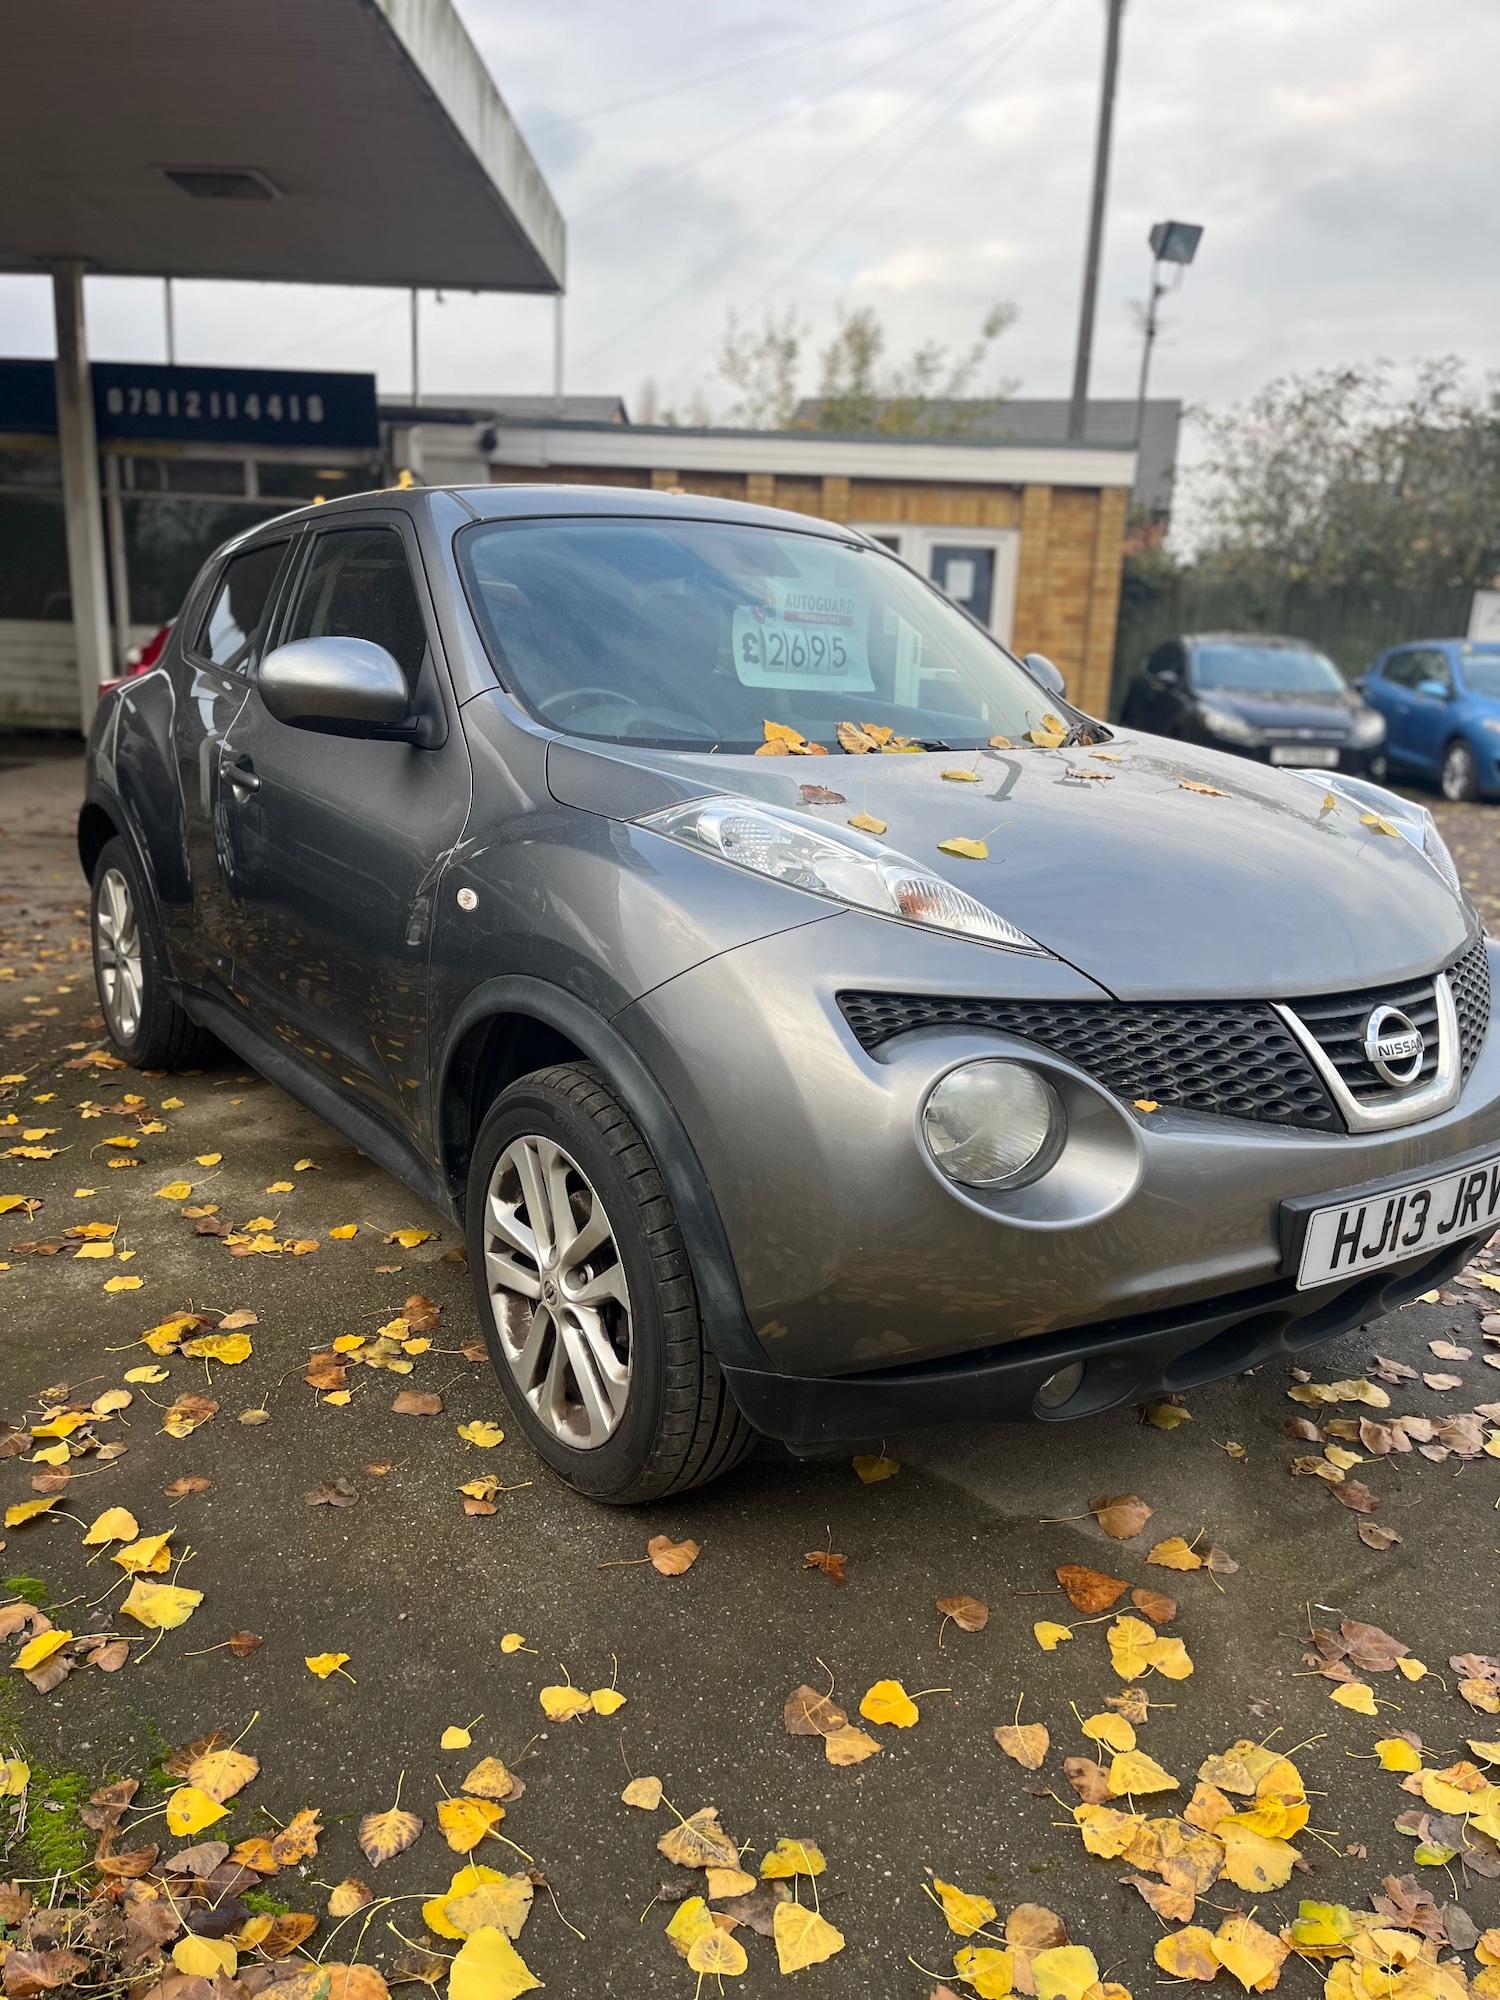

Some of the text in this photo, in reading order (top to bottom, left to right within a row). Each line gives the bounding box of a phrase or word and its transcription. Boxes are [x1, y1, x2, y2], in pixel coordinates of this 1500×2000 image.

[785, 593, 855, 614] AUTOGUARD
[742, 632, 847, 668] £2695
[1377, 1033, 1423, 1056] NISSAN
[1329, 1189, 1432, 1269] HJ13
